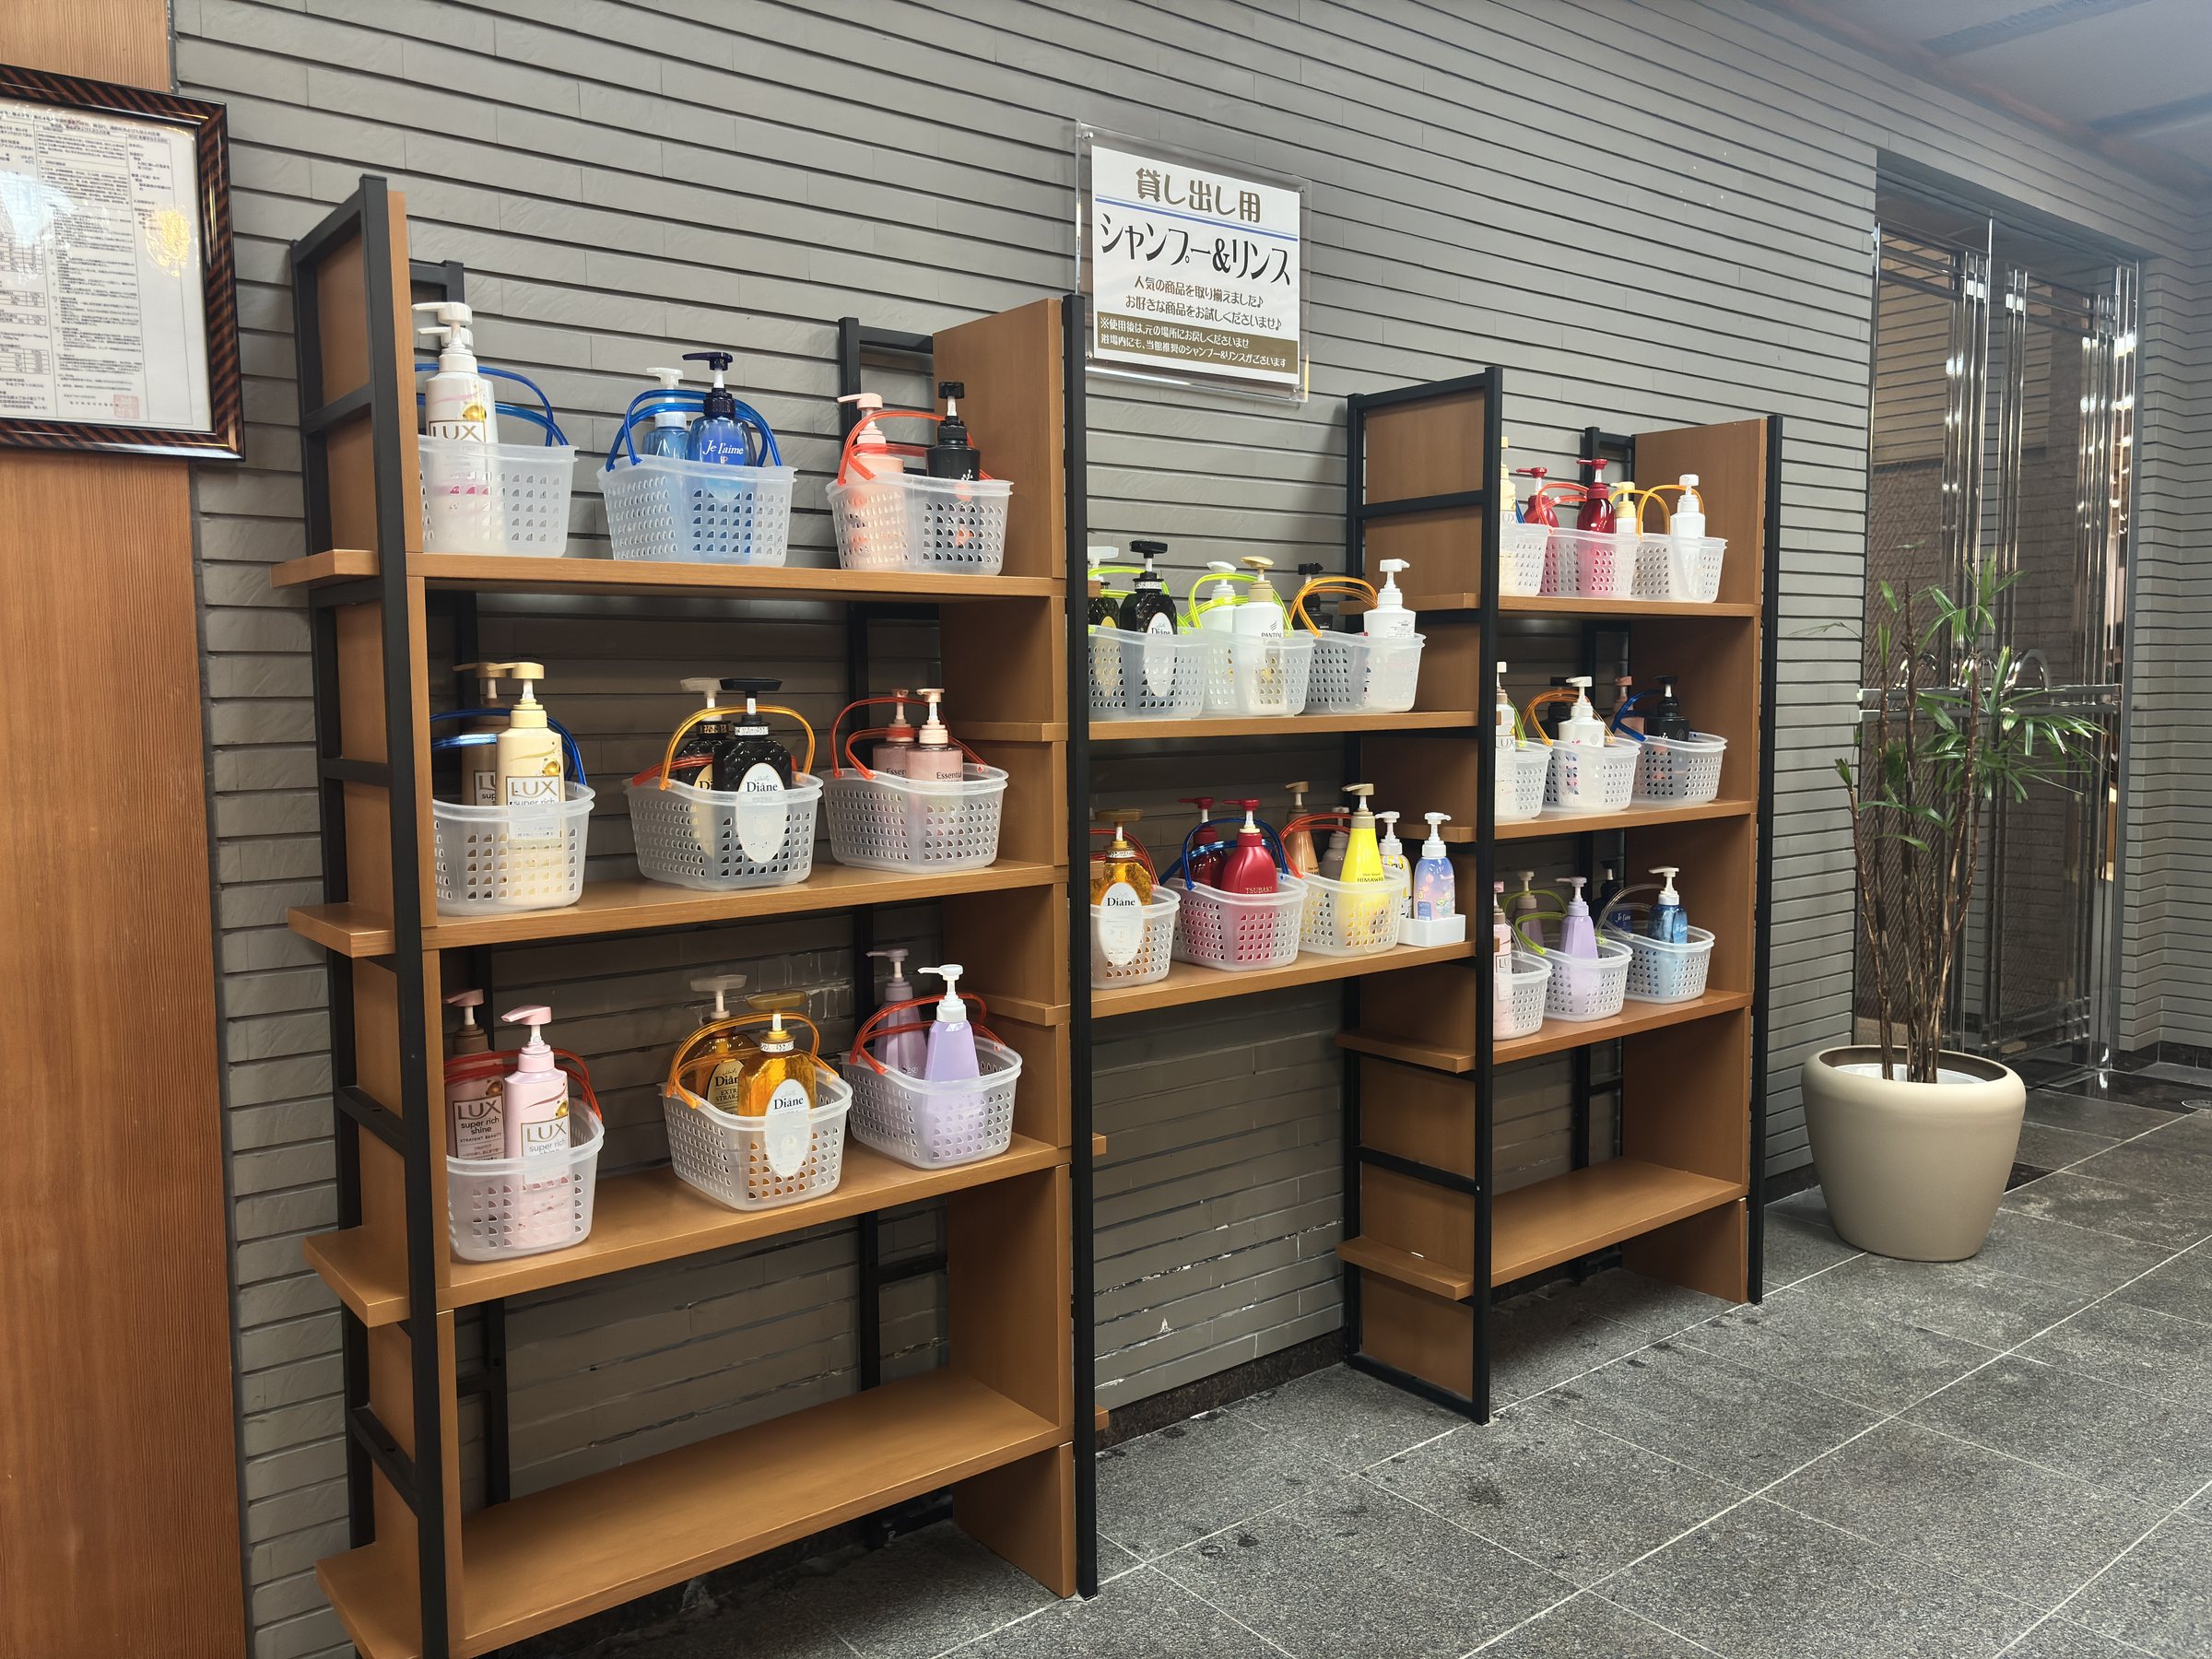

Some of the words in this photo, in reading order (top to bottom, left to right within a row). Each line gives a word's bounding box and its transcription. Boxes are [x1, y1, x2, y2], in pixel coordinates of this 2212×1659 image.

[1135, 167, 1261, 223] 貸し出し用
[1100, 213, 1290, 286] シャンプー&リンス
[702, 440, 717, 455] Je
[718, 442, 744, 454] l'aime
[886, 768, 906, 776] Essen
[511, 781, 558, 798] LUX
[715, 1093, 737, 1102] STRAIG
[721, 1088, 737, 1097] EXTR
[457, 1100, 501, 1120] LUX
[461, 1121, 484, 1130] super
[486, 1116, 500, 1125] rich
[471, 1126, 492, 1135] shine
[527, 1122, 567, 1142] LUX
[529, 1143, 552, 1152] super
[554, 1139, 566, 1147] rich
